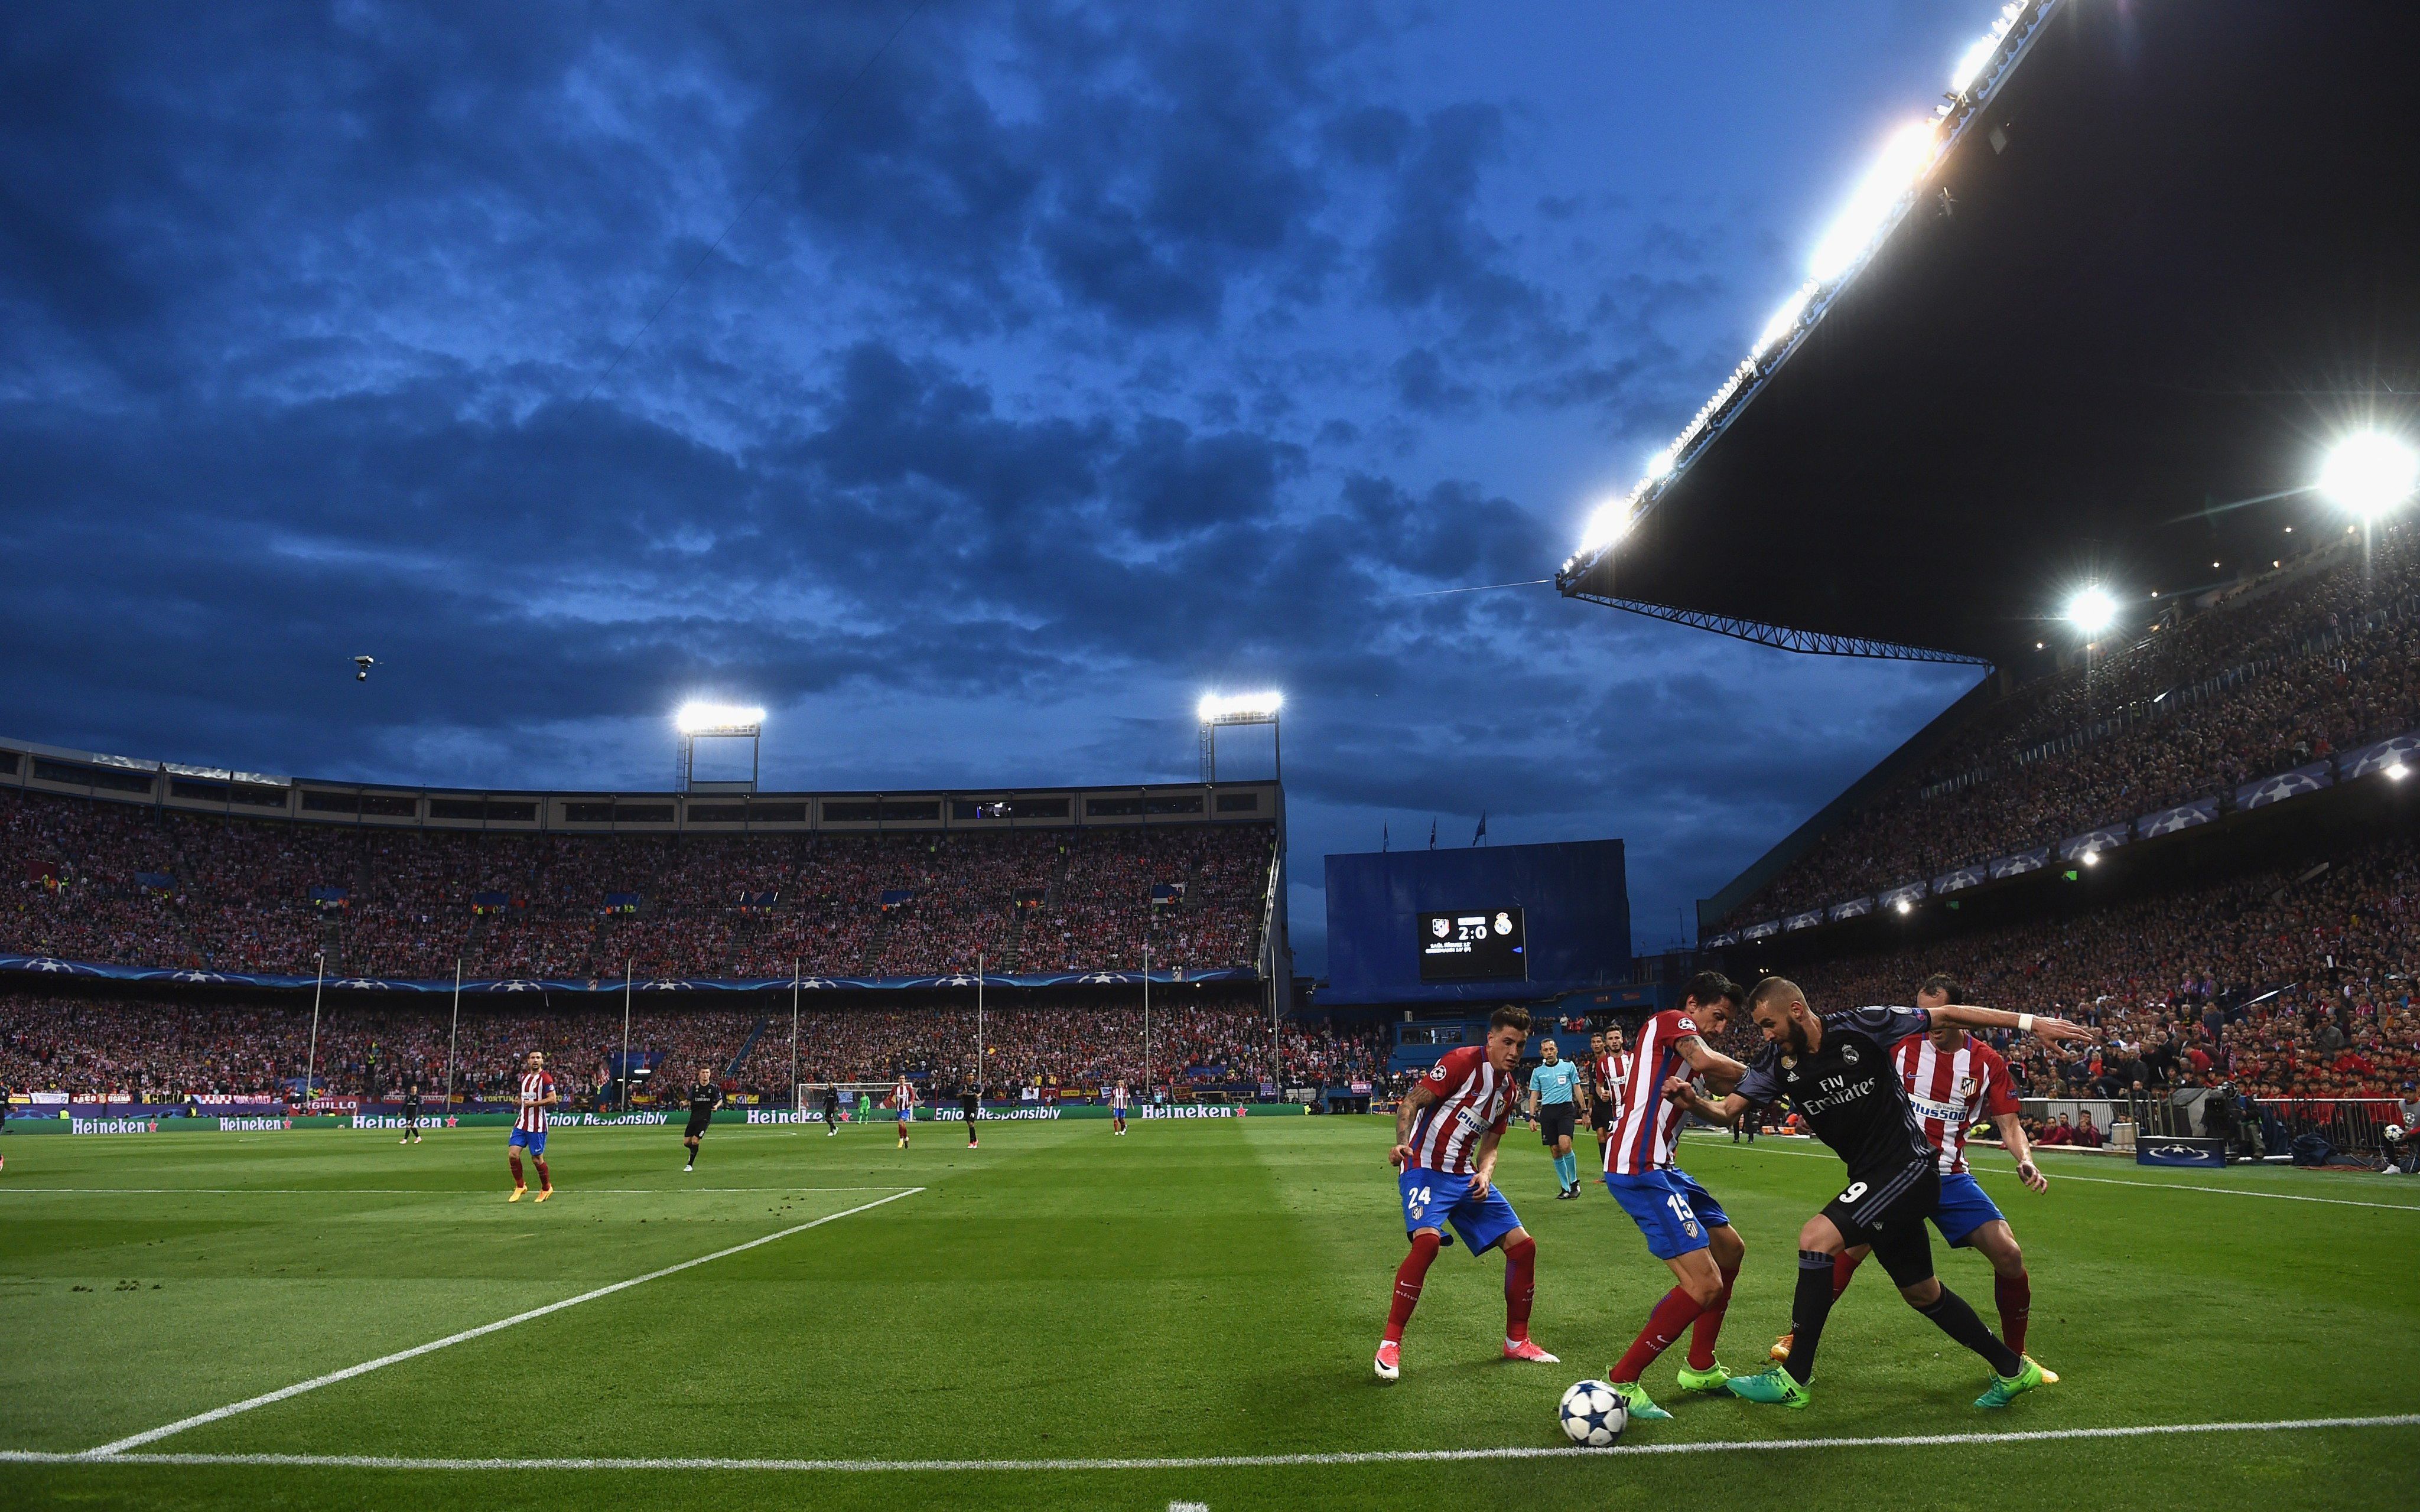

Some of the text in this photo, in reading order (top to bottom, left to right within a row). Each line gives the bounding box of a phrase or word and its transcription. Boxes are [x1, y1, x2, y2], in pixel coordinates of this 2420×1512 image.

[1458, 926, 1487, 940] 2:0
[1819, 1075, 1844, 1091] Fly
[1802, 1077, 1875, 1115] Emirates
[747, 1110, 825, 1124] Heineke
[935, 1107, 964, 1120] Enjo
[72, 1118, 145, 1135] Heineken
[219, 1117, 281, 1131] Heineken
[1608, 1120, 1614, 1130] 7
[1409, 1186, 1431, 1210] 24
[1839, 1182, 1868, 1203] 9
[1667, 1193, 1694, 1221] 15
